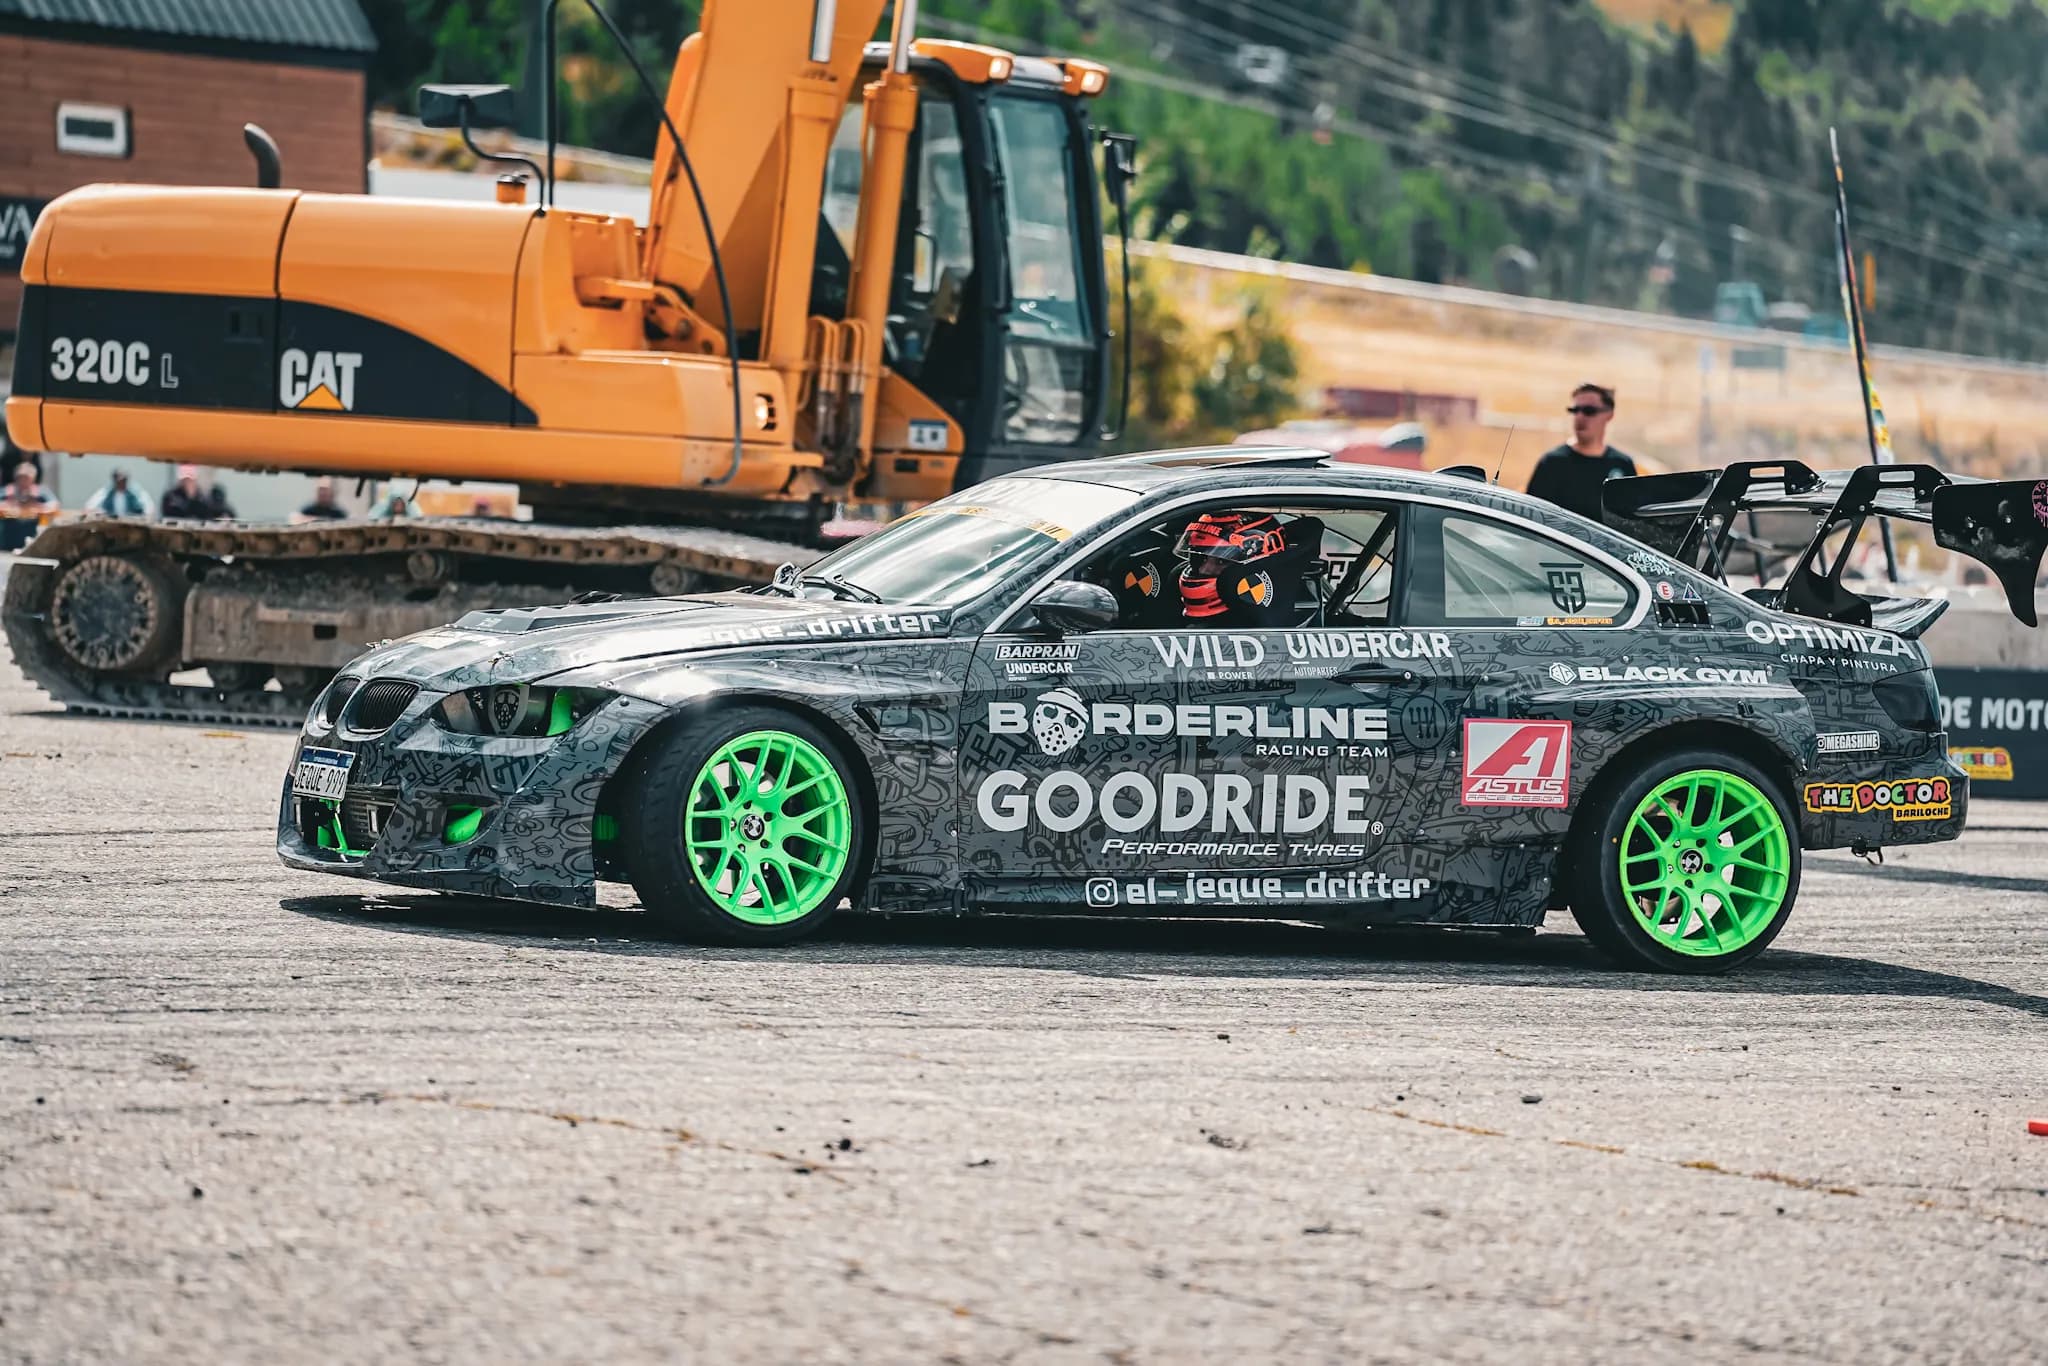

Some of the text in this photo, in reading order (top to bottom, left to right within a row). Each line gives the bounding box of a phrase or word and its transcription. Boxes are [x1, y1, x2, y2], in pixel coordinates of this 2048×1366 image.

[51, 337, 178, 388] 320C L
[280, 348, 362, 411] CAT
[1285, 632, 1454, 658] UNDERCAR
[1745, 620, 1917, 660] OPTIMIZA
[999, 645, 1077, 658] BARPRAN
[1151, 635, 1265, 668] WILD
[1005, 662, 1074, 674] UNDERCAR
[1780, 653, 1898, 673] CHAPA Y PINTURA
[1218, 671, 1254, 680] POWER
[1578, 666, 1769, 684] BLACK GYM
[1981, 697, 2048, 731] MOT
[1256, 744, 1389, 758] RACING TEAM
[1826, 734, 1878, 750] MEGASHINE
[295, 763, 346, 795] JEQUE 999
[1468, 778, 1563, 795] ASTUS
[1808, 780, 1948, 809] THE DOCTOR
[1895, 807, 1949, 818] BARILOCHE
